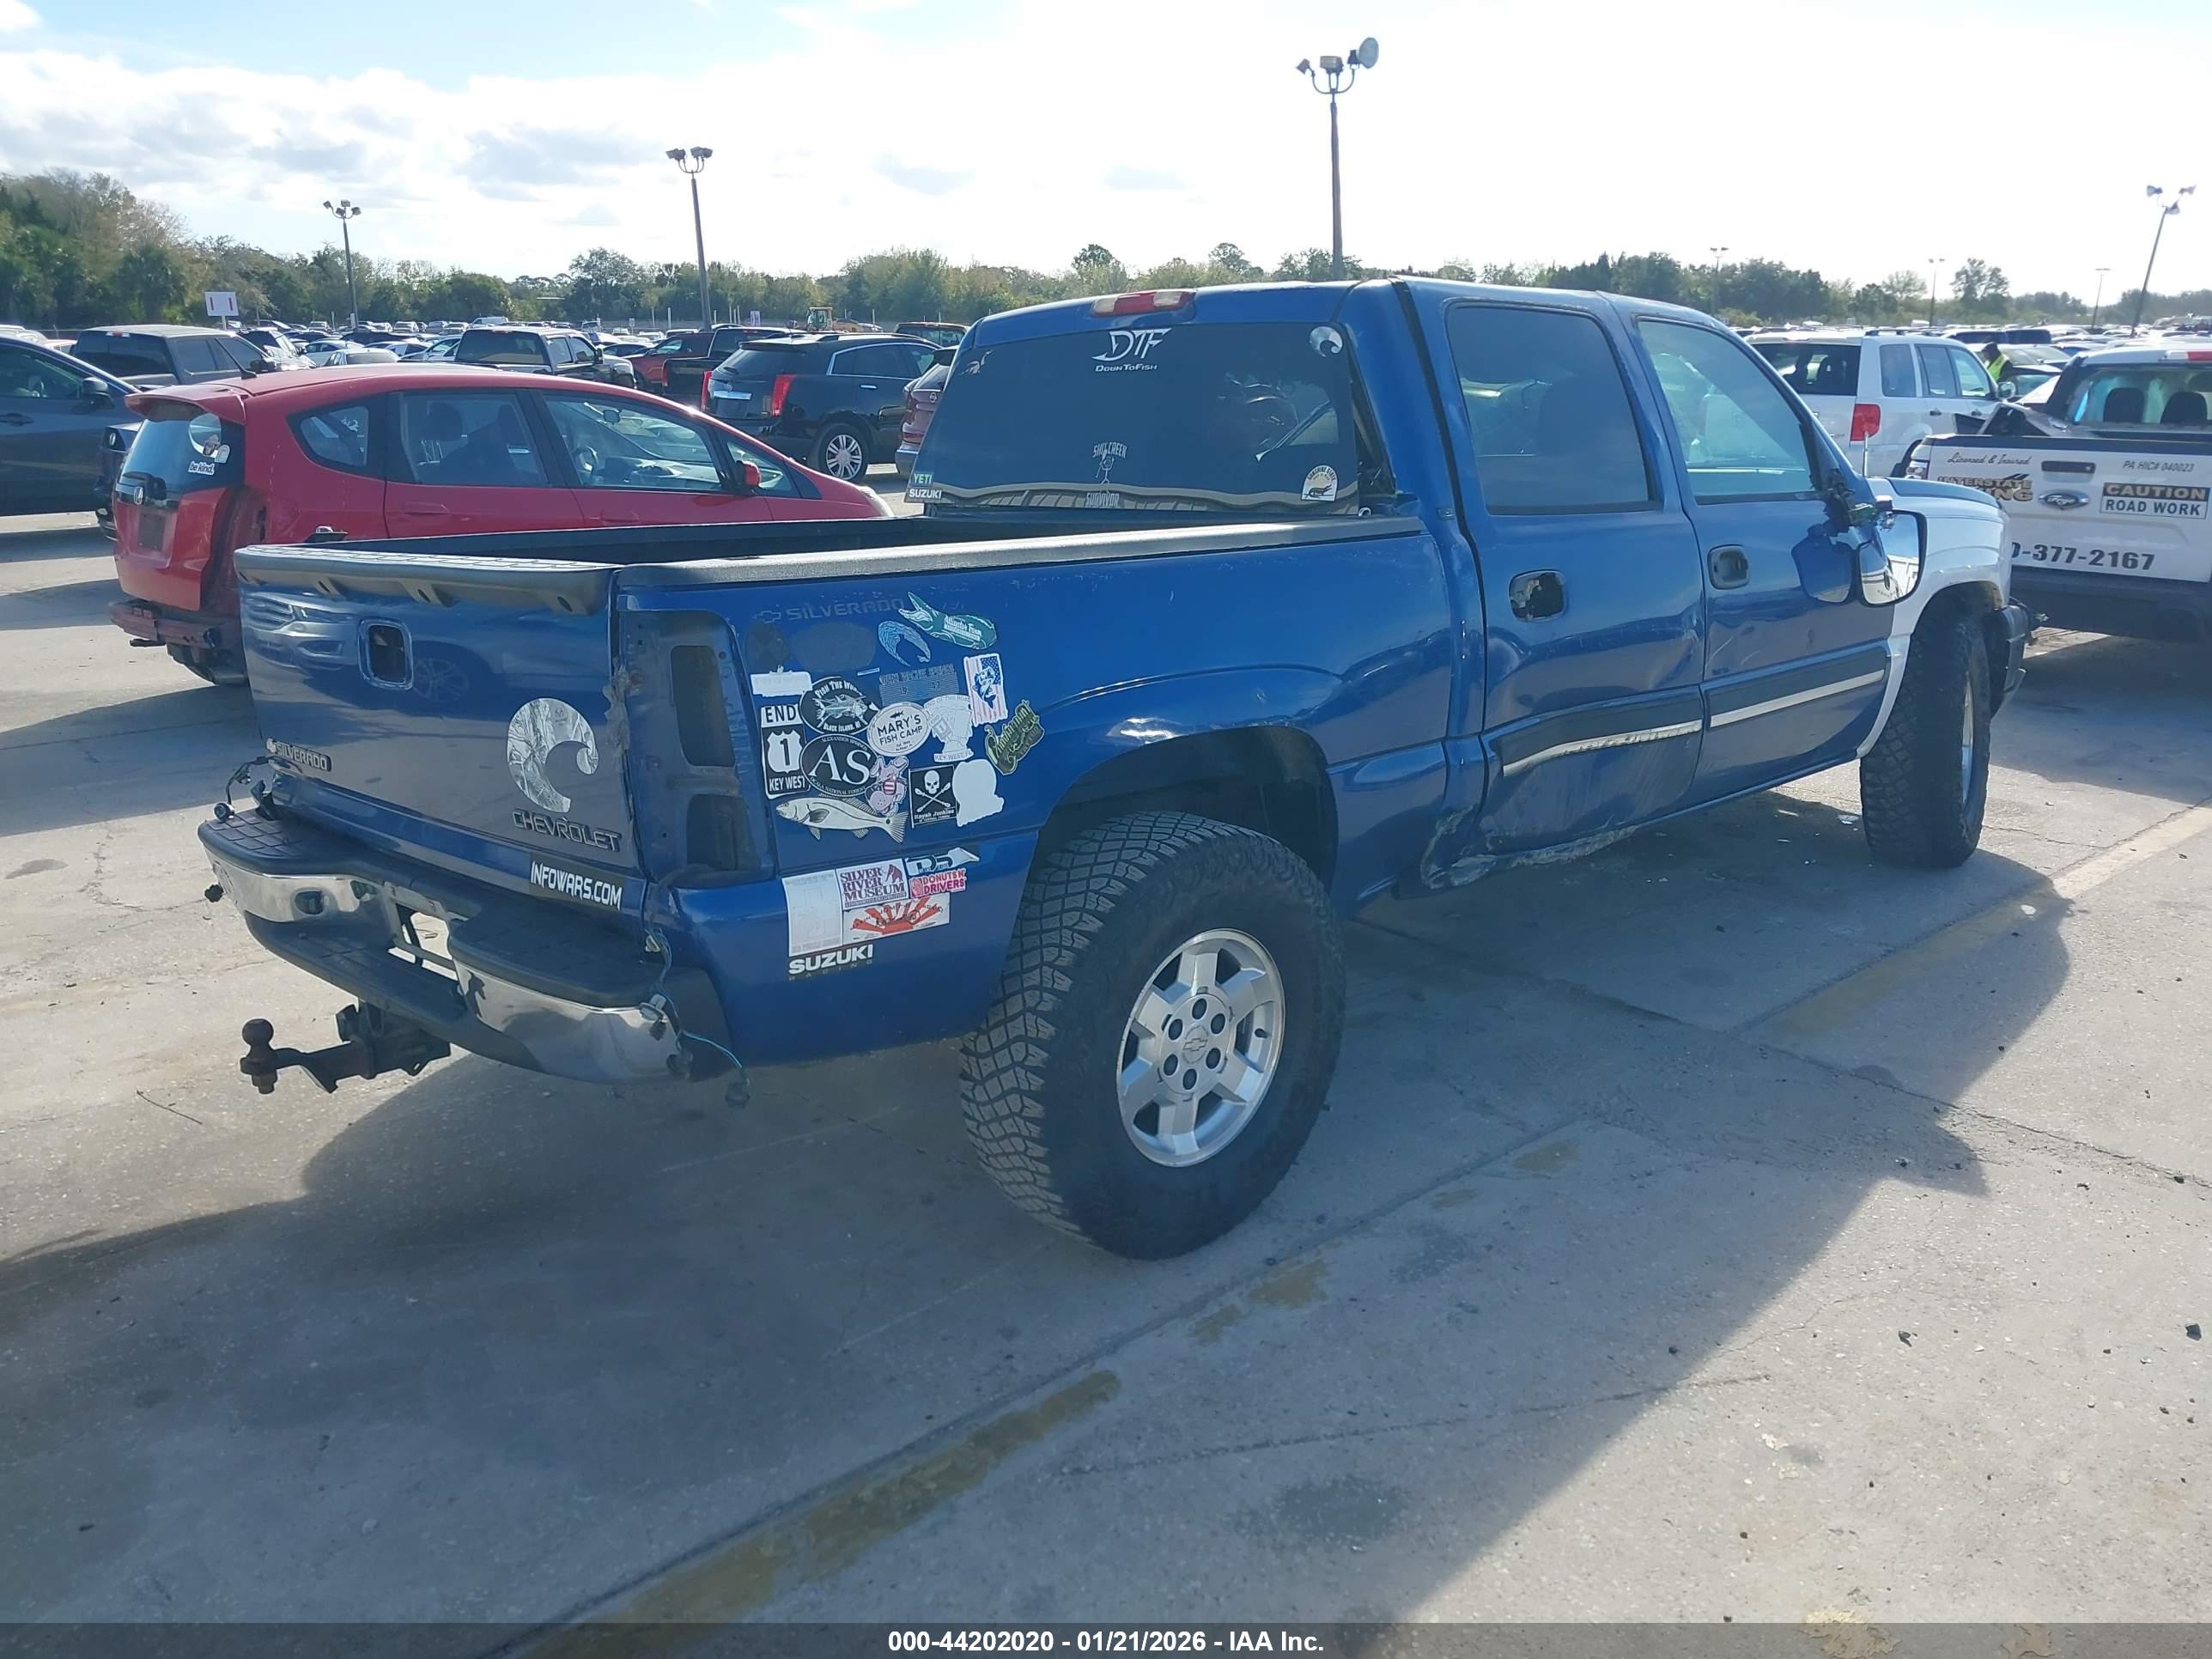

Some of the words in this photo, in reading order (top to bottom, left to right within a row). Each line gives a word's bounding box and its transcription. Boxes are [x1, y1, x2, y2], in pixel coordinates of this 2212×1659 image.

[1092, 328, 1172, 361] DTF
[1108, 442, 1127, 459] CREEK
[1947, 452, 1987, 464] Licensed
[1988, 454, 1997, 464] &
[1998, 453, 2033, 465] Insured
[2123, 460, 2135, 470] PA
[914, 474, 933, 484] YETI
[909, 489, 942, 499] SUZUKI
[1085, 492, 1120, 508] SURVIVOR
[2106, 483, 2206, 500] CAUTION
[2106, 499, 2147, 513] ROAD
[2154, 501, 2201, 515] WORK
[814, 684, 830, 699] FISH
[830, 680, 843, 690] THE
[765, 705, 797, 723] END
[878, 714, 921, 737] MARY'S
[879, 734, 897, 745] FISH
[899, 726, 923, 738] CAMP
[276, 744, 327, 770] SILVERADO
[780, 738, 790, 766] 1
[808, 744, 872, 785] AS
[769, 777, 784, 791] KEY
[786, 775, 805, 789] WEST
[513, 810, 618, 851] CHEVROLET
[840, 867, 883, 882] SILVER
[923, 870, 957, 884] DONUTS
[531, 860, 623, 911] INFOWARS.COM
[843, 878, 883, 893] RIVER
[844, 883, 905, 902] MUSEUM
[924, 878, 964, 894] DRIVERS
[789, 944, 873, 975] SUZUKI
